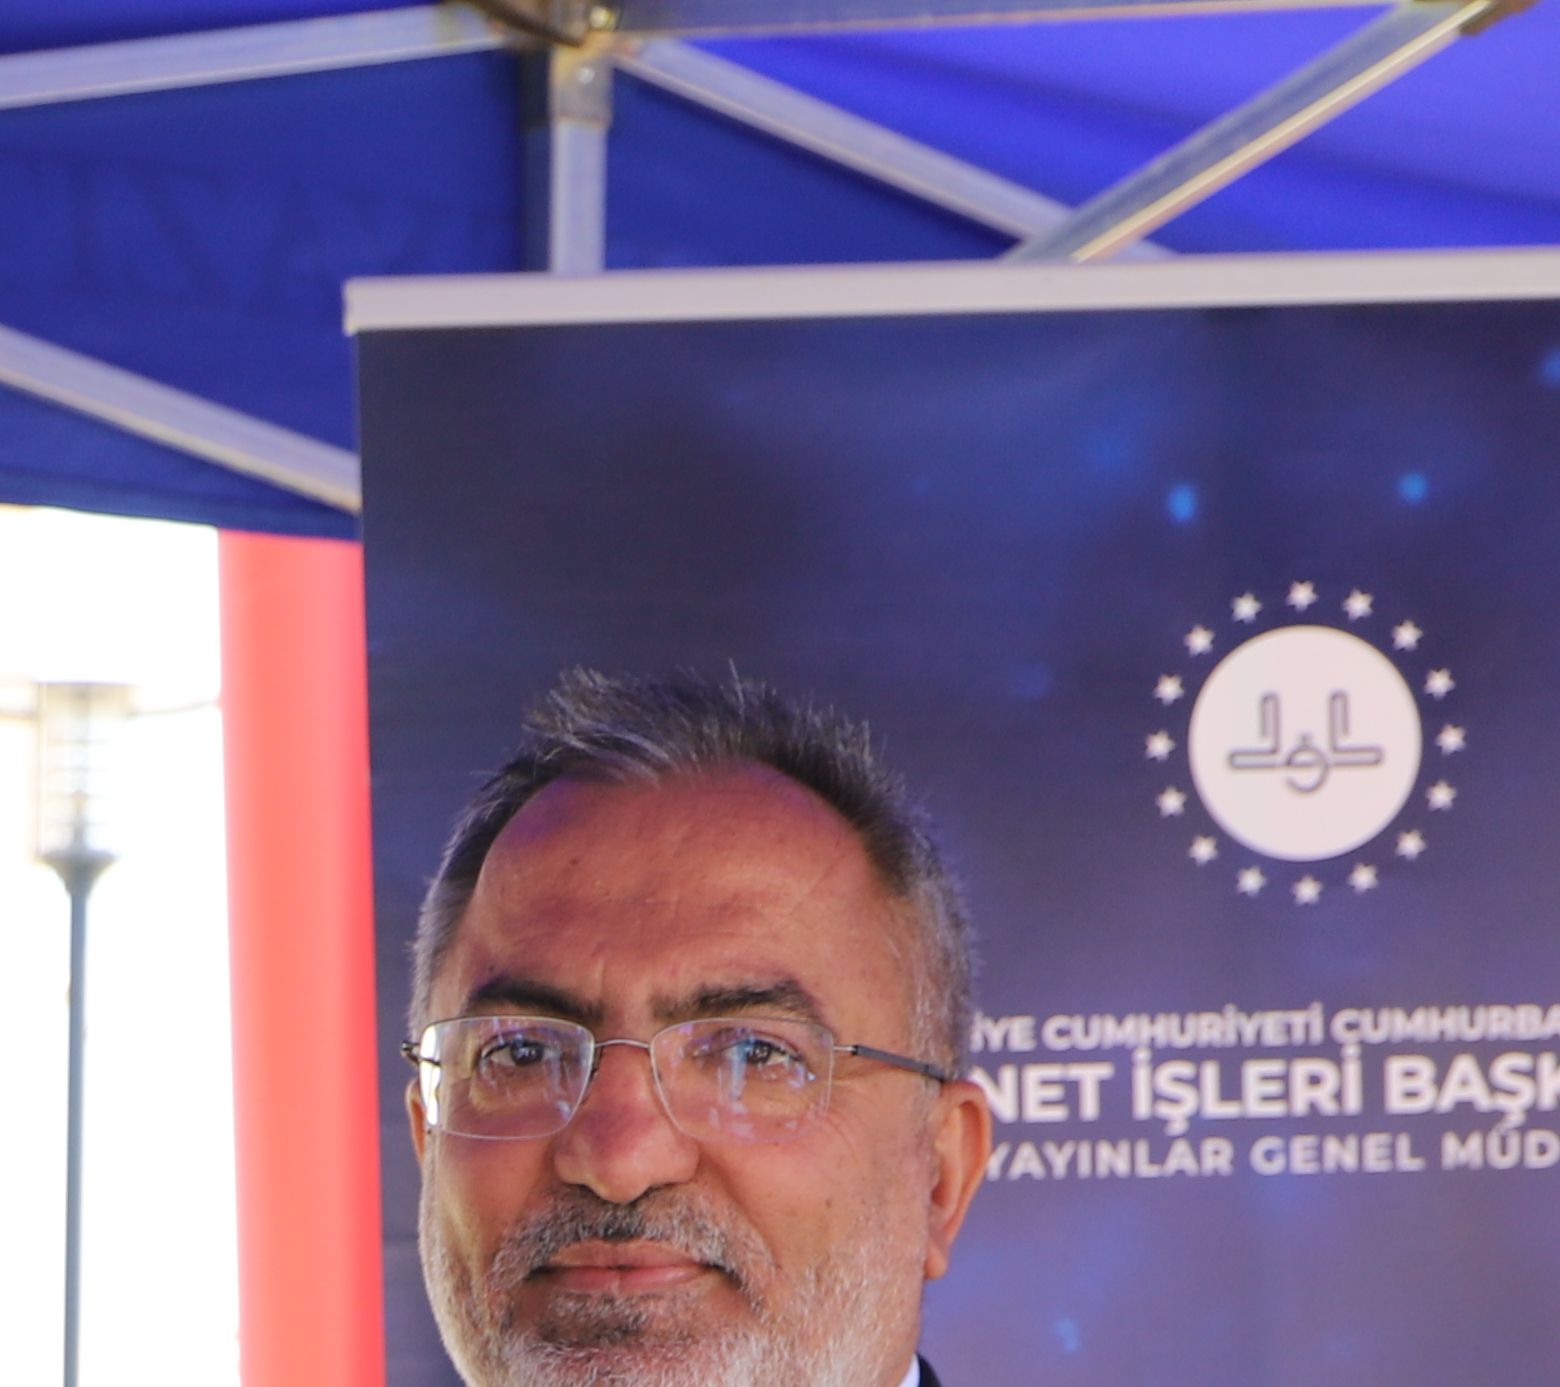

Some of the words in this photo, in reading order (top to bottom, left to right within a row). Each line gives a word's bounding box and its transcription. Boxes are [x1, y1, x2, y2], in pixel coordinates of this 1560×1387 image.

[1041, 1000, 1323, 1050] CUMHURİYETİ
[1132, 1043, 1362, 1124] İŞLERİ
[1250, 1130, 1424, 1175] GENEL
